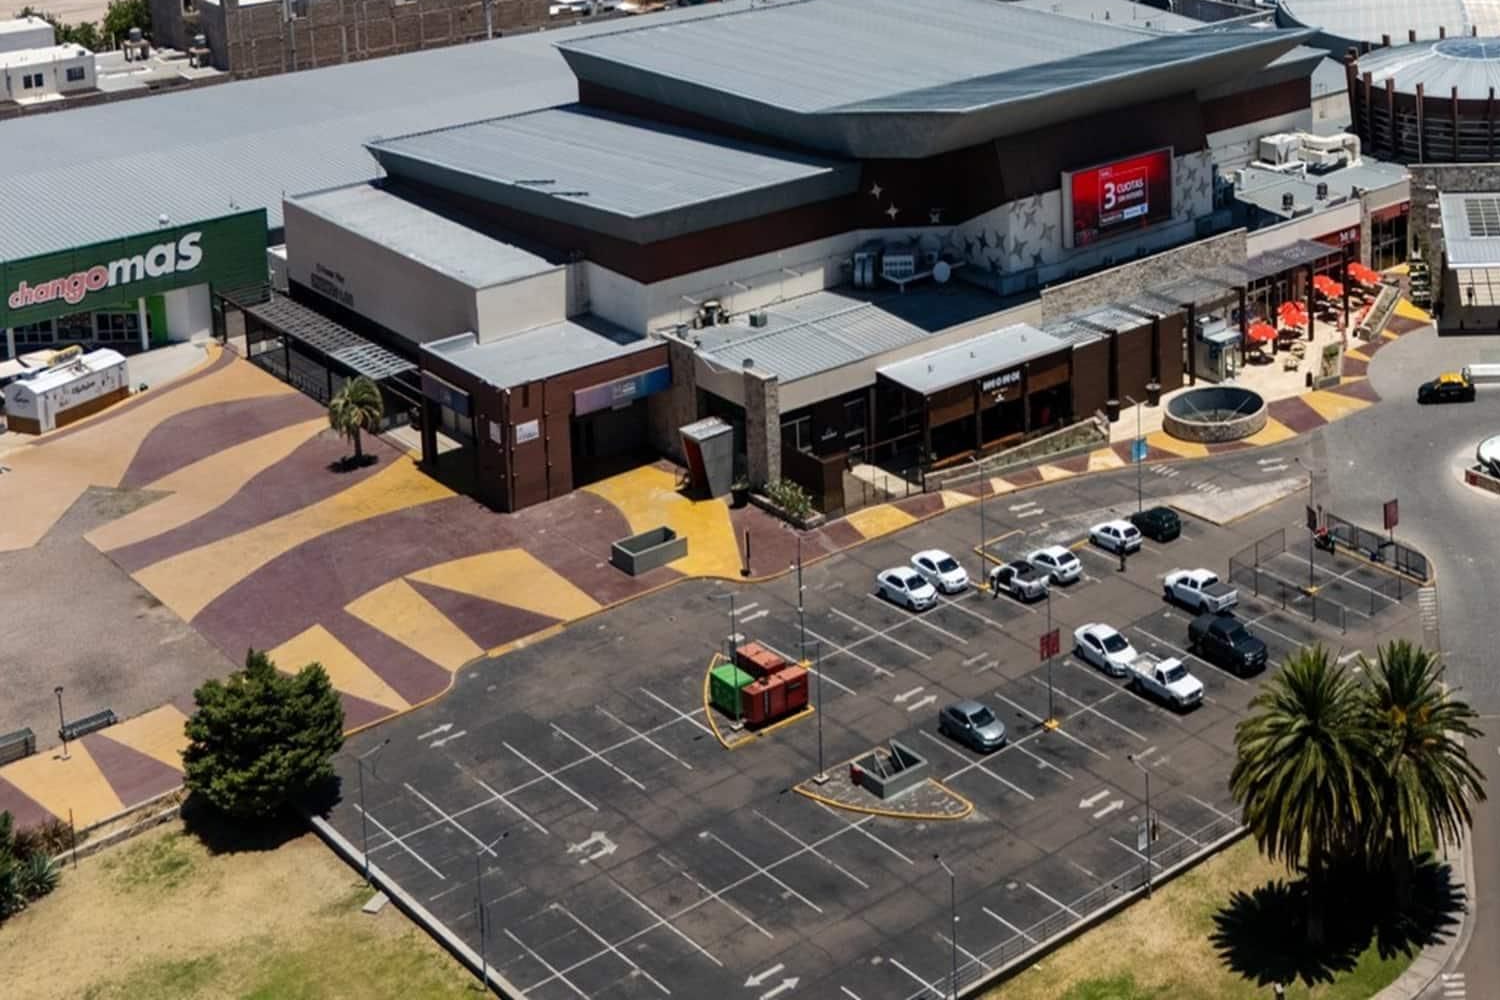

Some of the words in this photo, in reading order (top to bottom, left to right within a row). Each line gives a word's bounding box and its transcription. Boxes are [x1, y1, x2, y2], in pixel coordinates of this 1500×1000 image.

[1104, 182, 1116, 210] 3
[1116, 178, 1145, 193] CUOTAS
[8, 231, 203, 309] changomas
